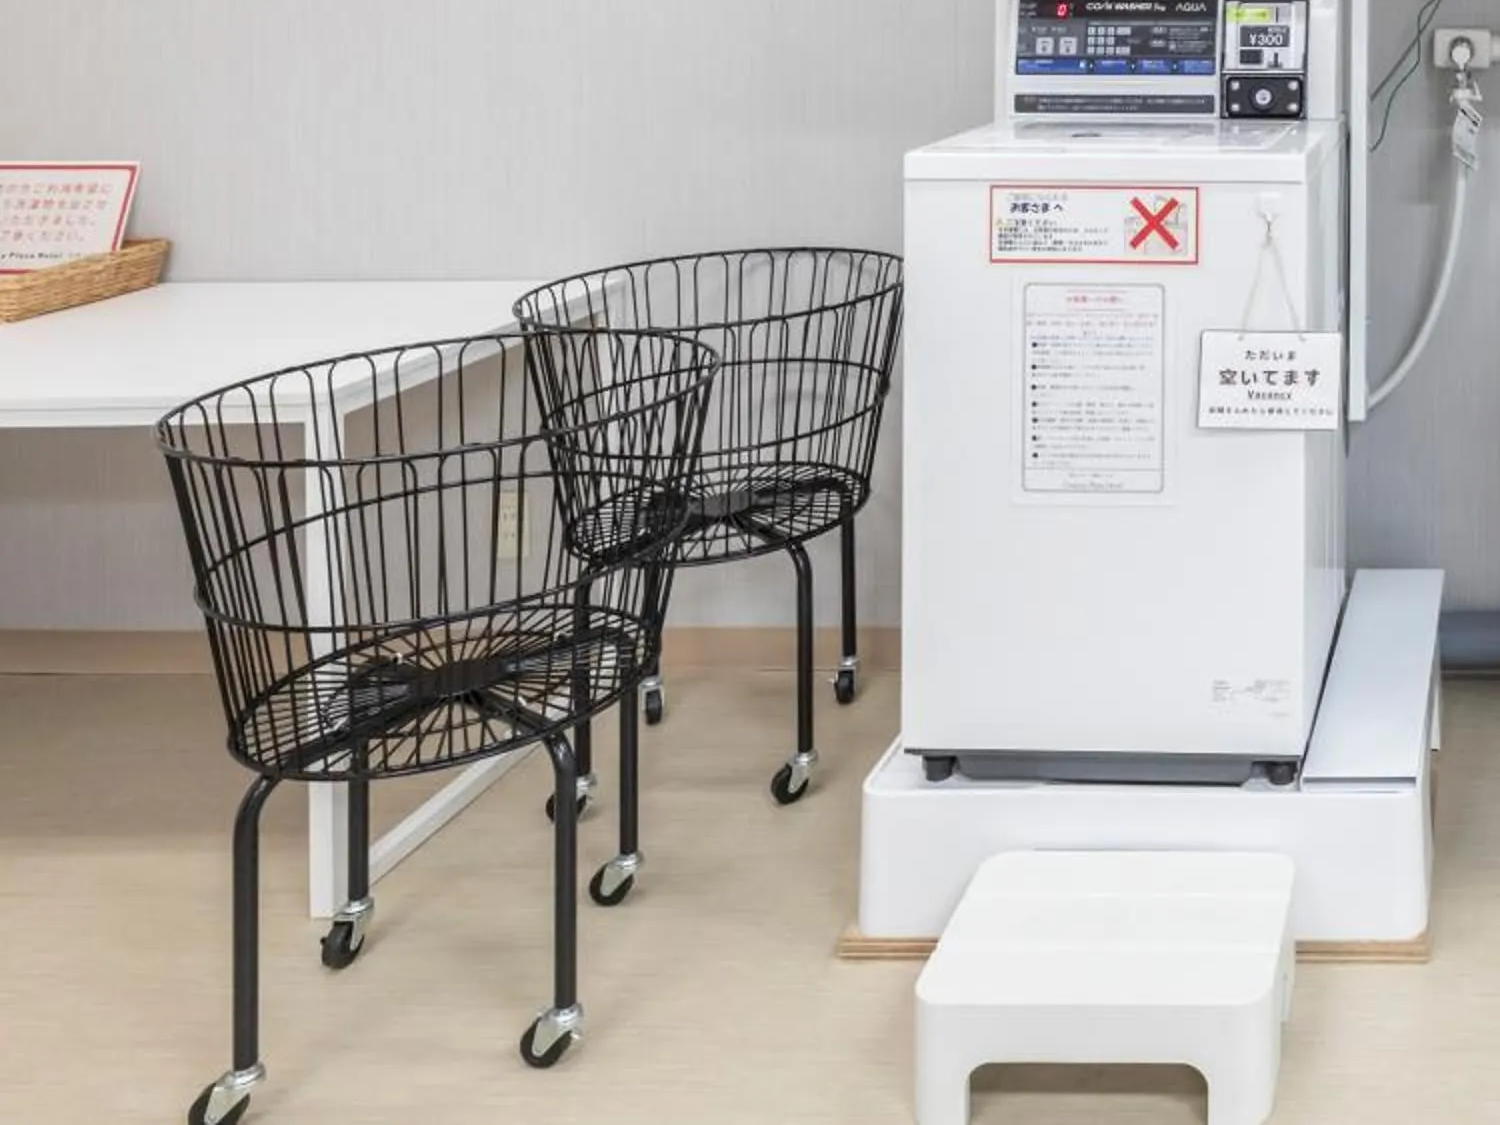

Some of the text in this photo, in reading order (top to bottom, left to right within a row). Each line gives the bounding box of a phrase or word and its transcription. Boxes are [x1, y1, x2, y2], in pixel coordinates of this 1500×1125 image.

[1175, 2, 1207, 12] AQUA
[1249, 33, 1283, 46] ¥300
[1244, 349, 1297, 361] ただいま
[1218, 368, 1321, 387] 空いてます
[1247, 390, 1292, 400] Vacancy
